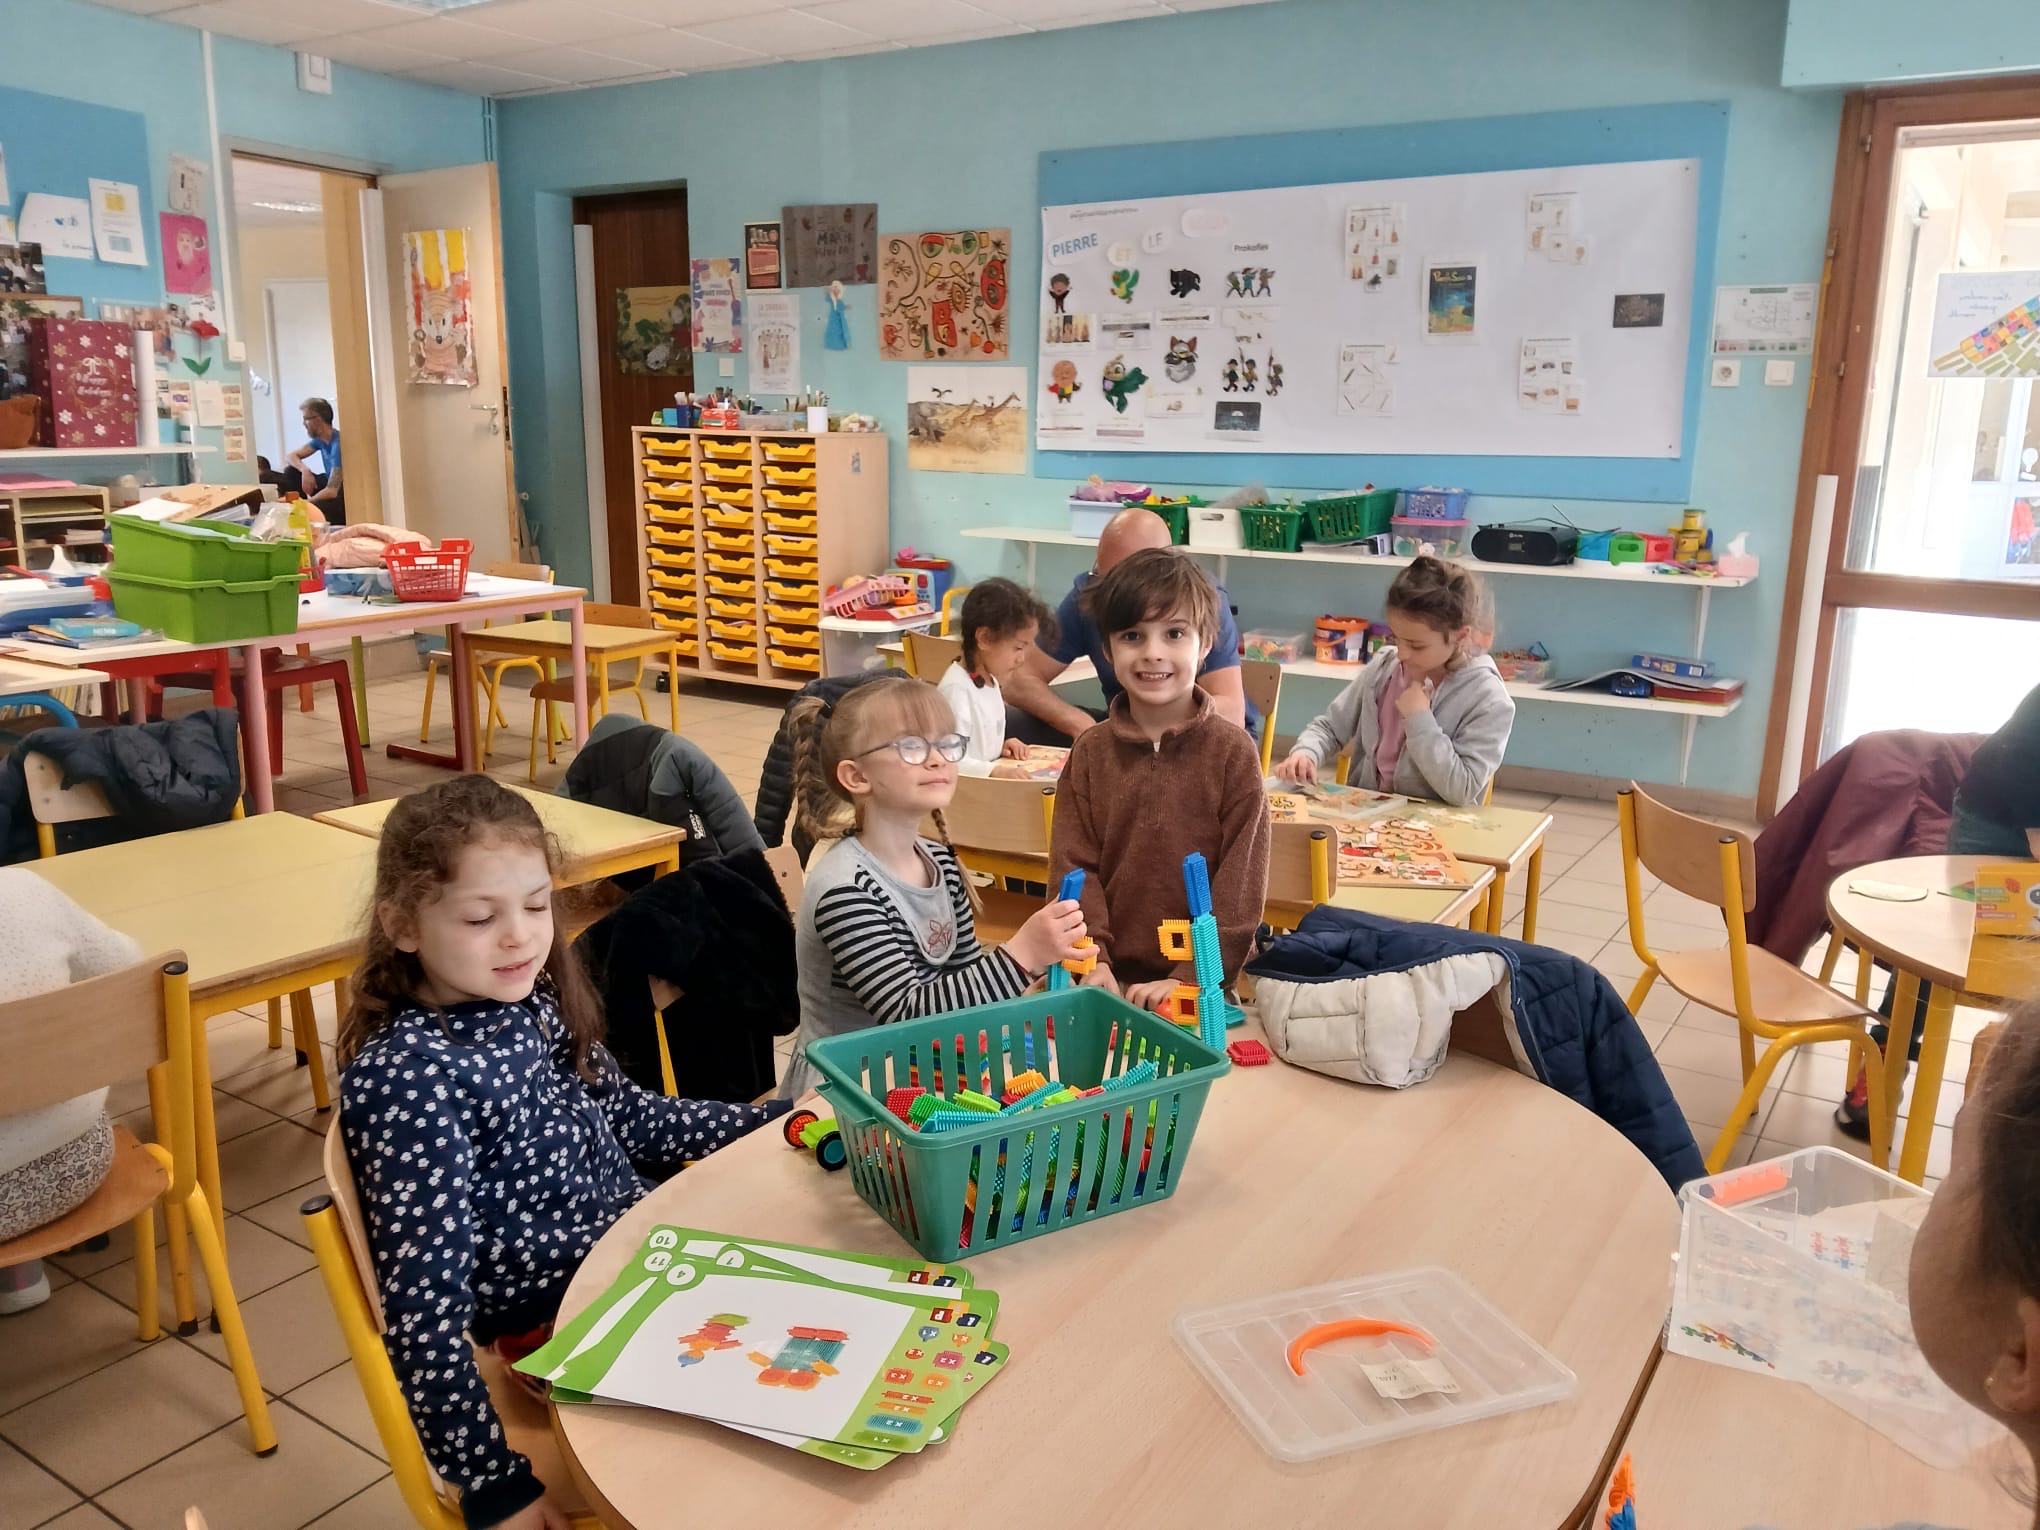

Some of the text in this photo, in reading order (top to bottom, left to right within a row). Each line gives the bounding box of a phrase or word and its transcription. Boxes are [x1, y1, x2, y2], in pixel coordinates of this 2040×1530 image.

[1052, 232, 1099, 258] PIERRE
[655, 1235, 671, 1246] 10
[650, 1256, 666, 1266] 11
[676, 1270, 686, 1279] 4
